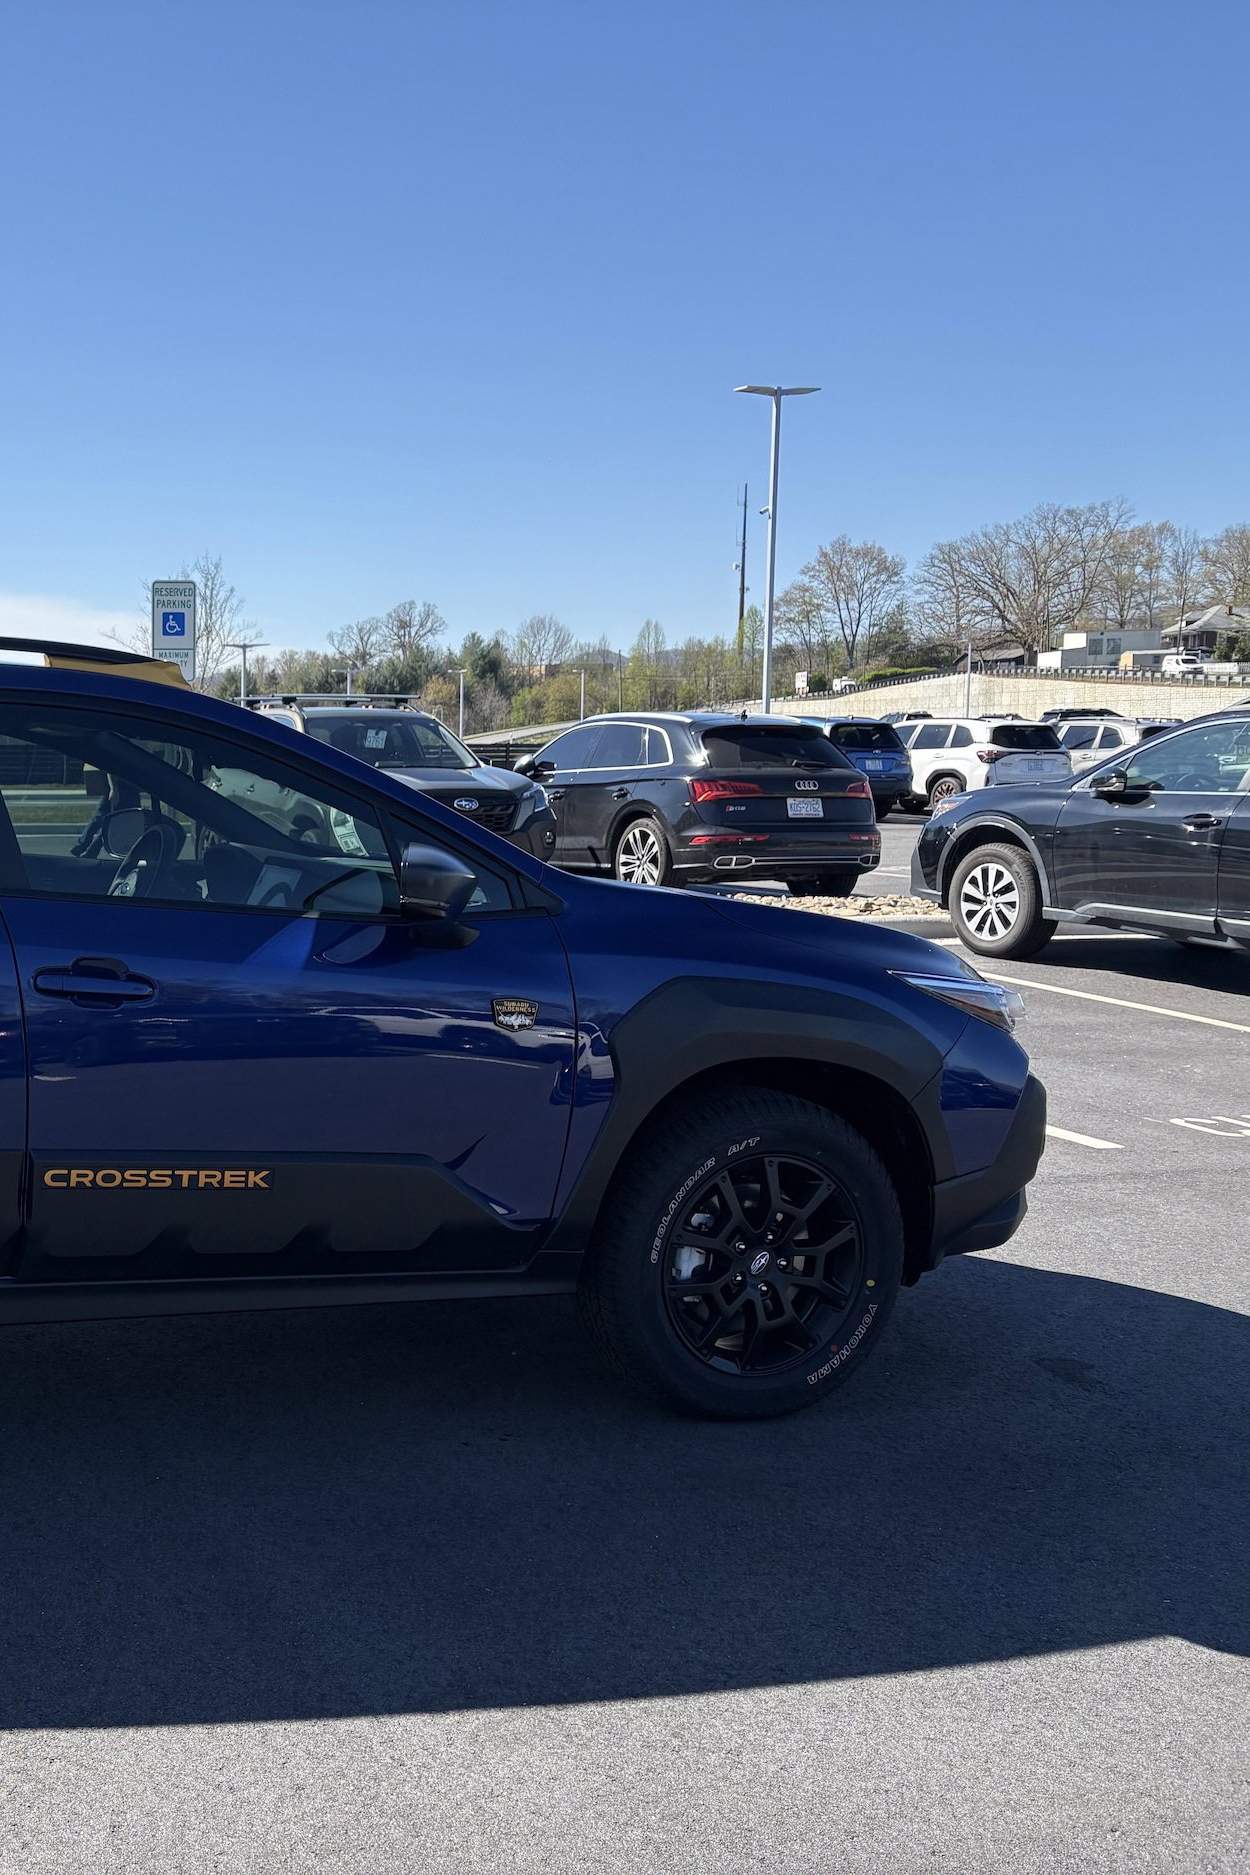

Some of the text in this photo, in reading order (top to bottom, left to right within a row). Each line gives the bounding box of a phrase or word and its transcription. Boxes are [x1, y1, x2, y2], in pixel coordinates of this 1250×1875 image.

[155, 588, 193, 597] RESERVED
[156, 600, 192, 609] PARKING
[366, 735, 385, 747] 9761
[43, 1169, 270, 1188] CROSSTREK
[651, 1136, 761, 1263] GEOLANDAR A/T
[807, 1303, 878, 1385] YOKOHAMA
